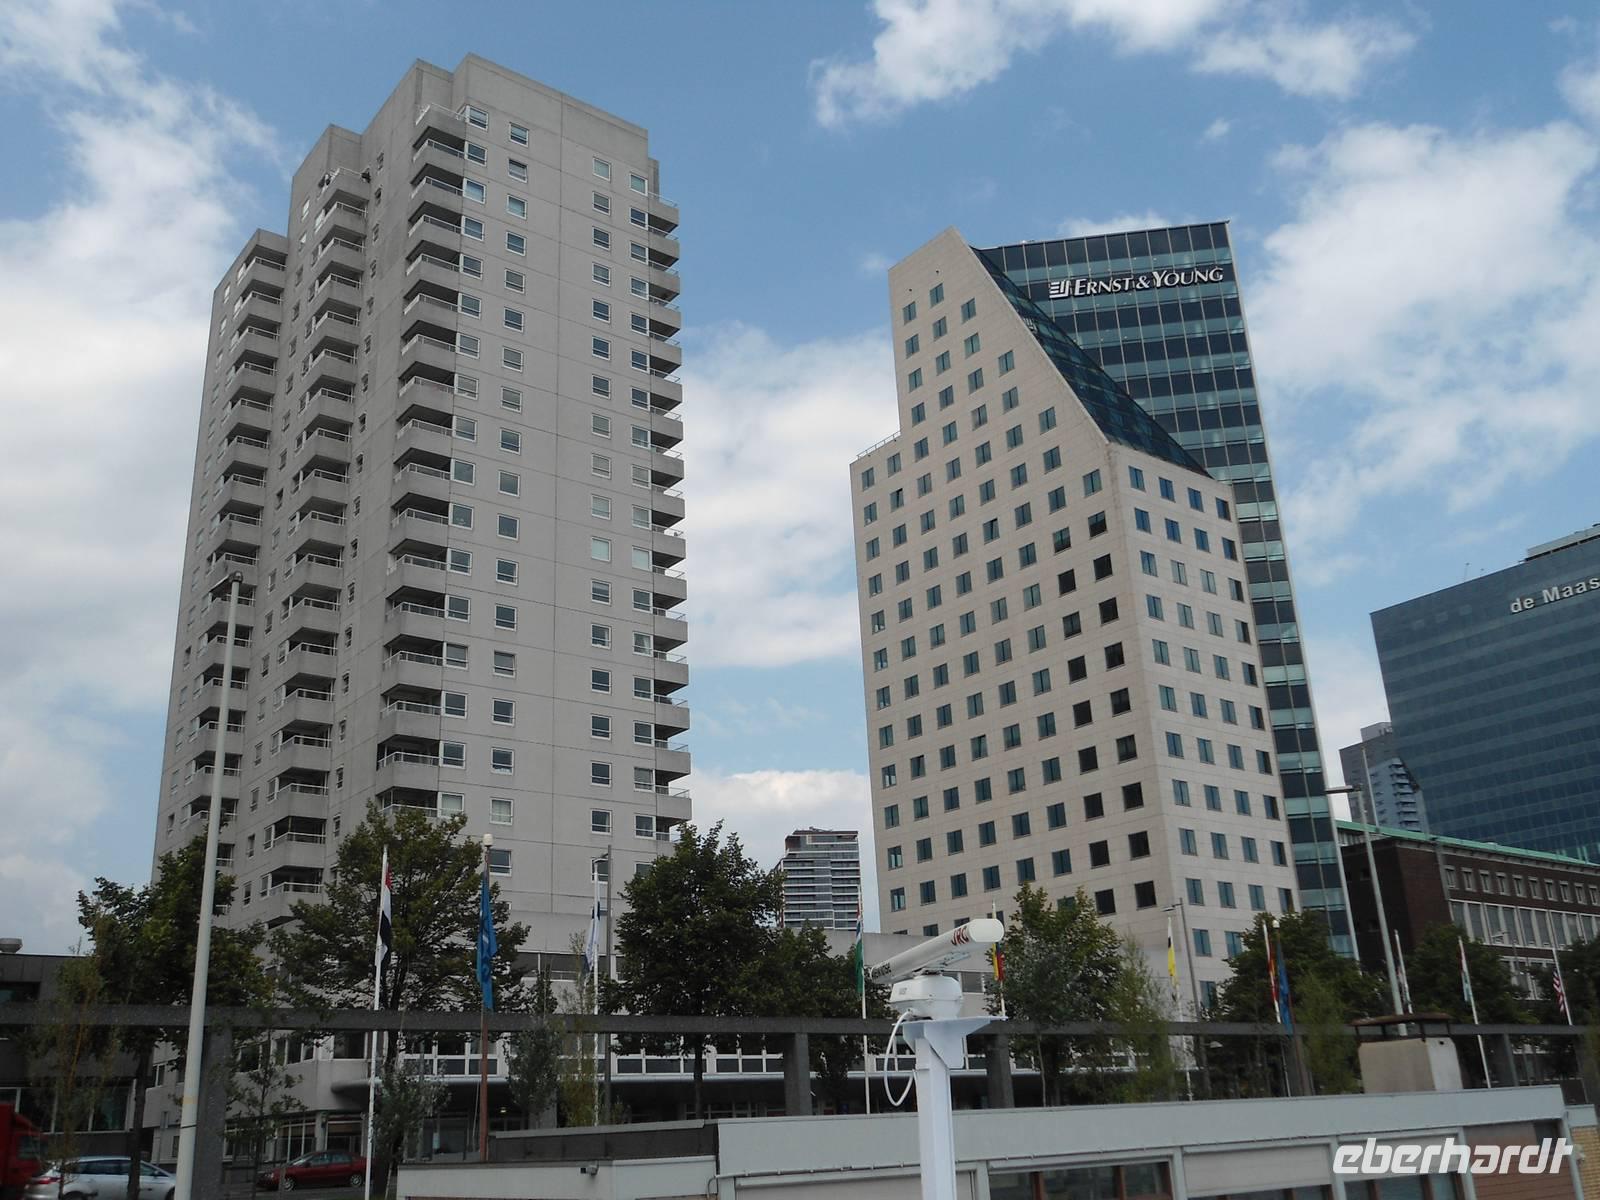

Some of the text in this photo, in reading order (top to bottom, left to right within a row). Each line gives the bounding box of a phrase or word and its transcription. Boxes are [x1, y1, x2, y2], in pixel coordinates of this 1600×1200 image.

[1074, 276, 1134, 296] ERNST
[1136, 275, 1150, 289] &
[1152, 267, 1224, 288] YOUNG
[1510, 577, 1600, 613] de Maas
[951, 926, 969, 946] JRC
